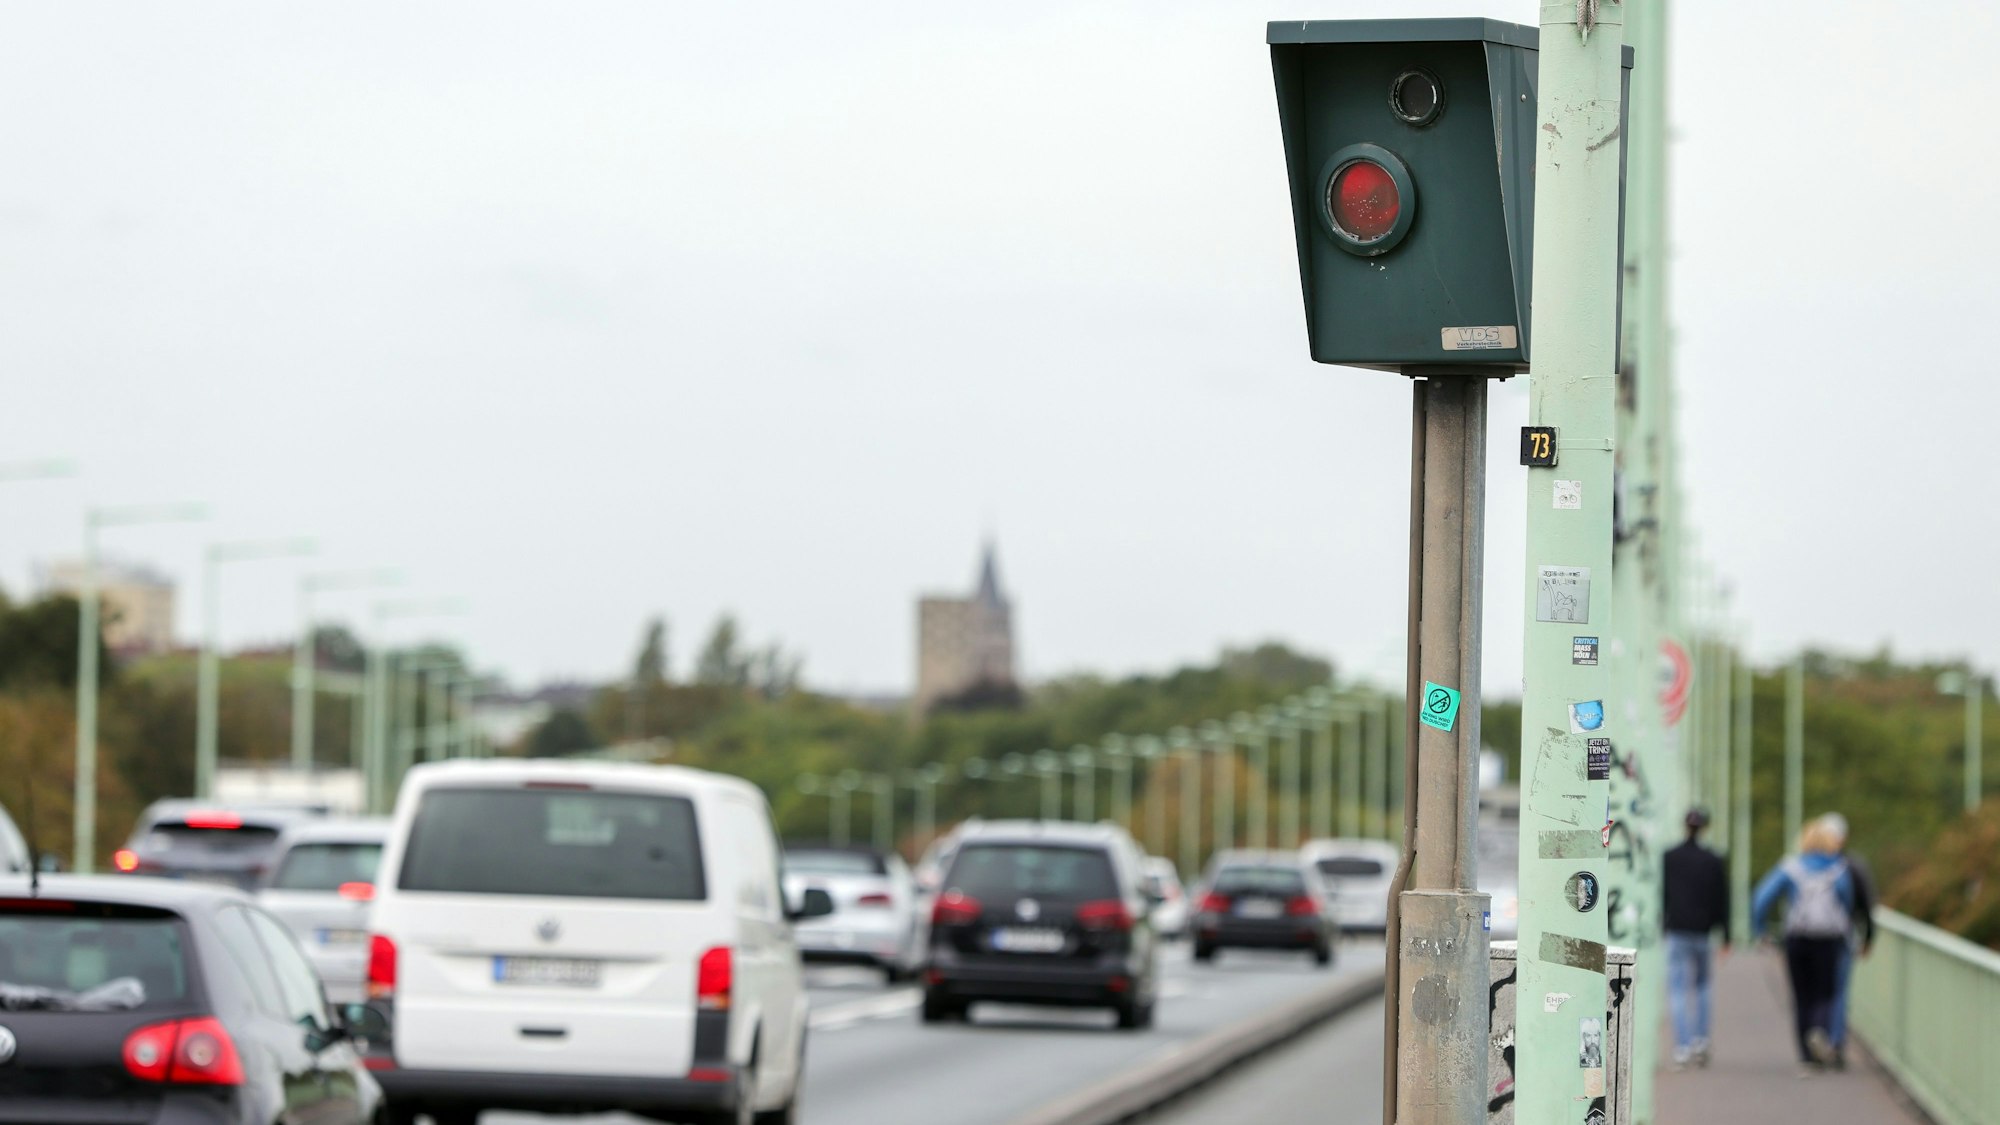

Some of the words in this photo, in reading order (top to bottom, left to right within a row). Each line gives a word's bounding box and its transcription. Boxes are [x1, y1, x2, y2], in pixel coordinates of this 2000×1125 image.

[1458, 327, 1500, 341] VDS
[1530, 433, 1550, 458] 73
[1574, 637, 1598, 645] CRITICAL
[1574, 644, 1592, 652] MASS
[1588, 738, 1602, 746] JETZT
